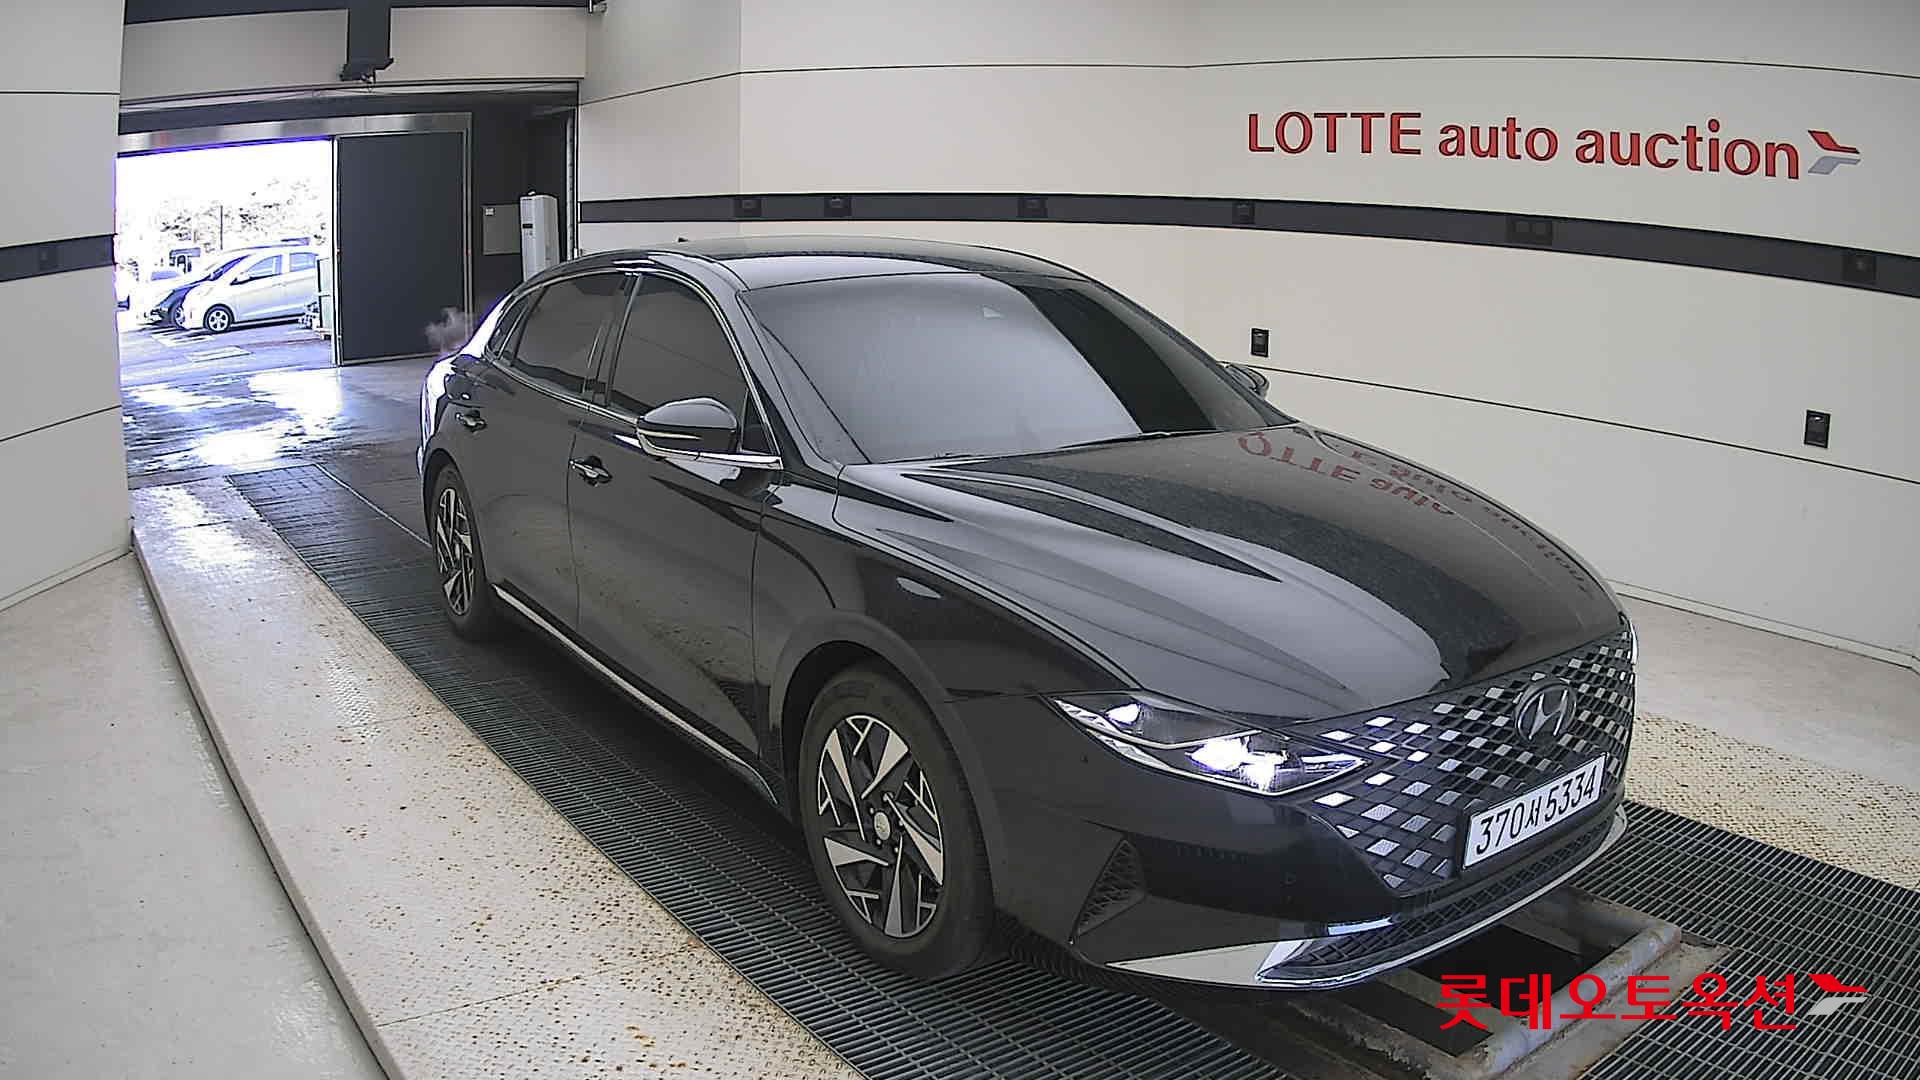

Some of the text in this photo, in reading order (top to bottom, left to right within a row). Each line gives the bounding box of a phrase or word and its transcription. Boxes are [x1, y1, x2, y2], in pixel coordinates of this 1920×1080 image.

[1248, 112, 1800, 180] LOTTE auto auction
